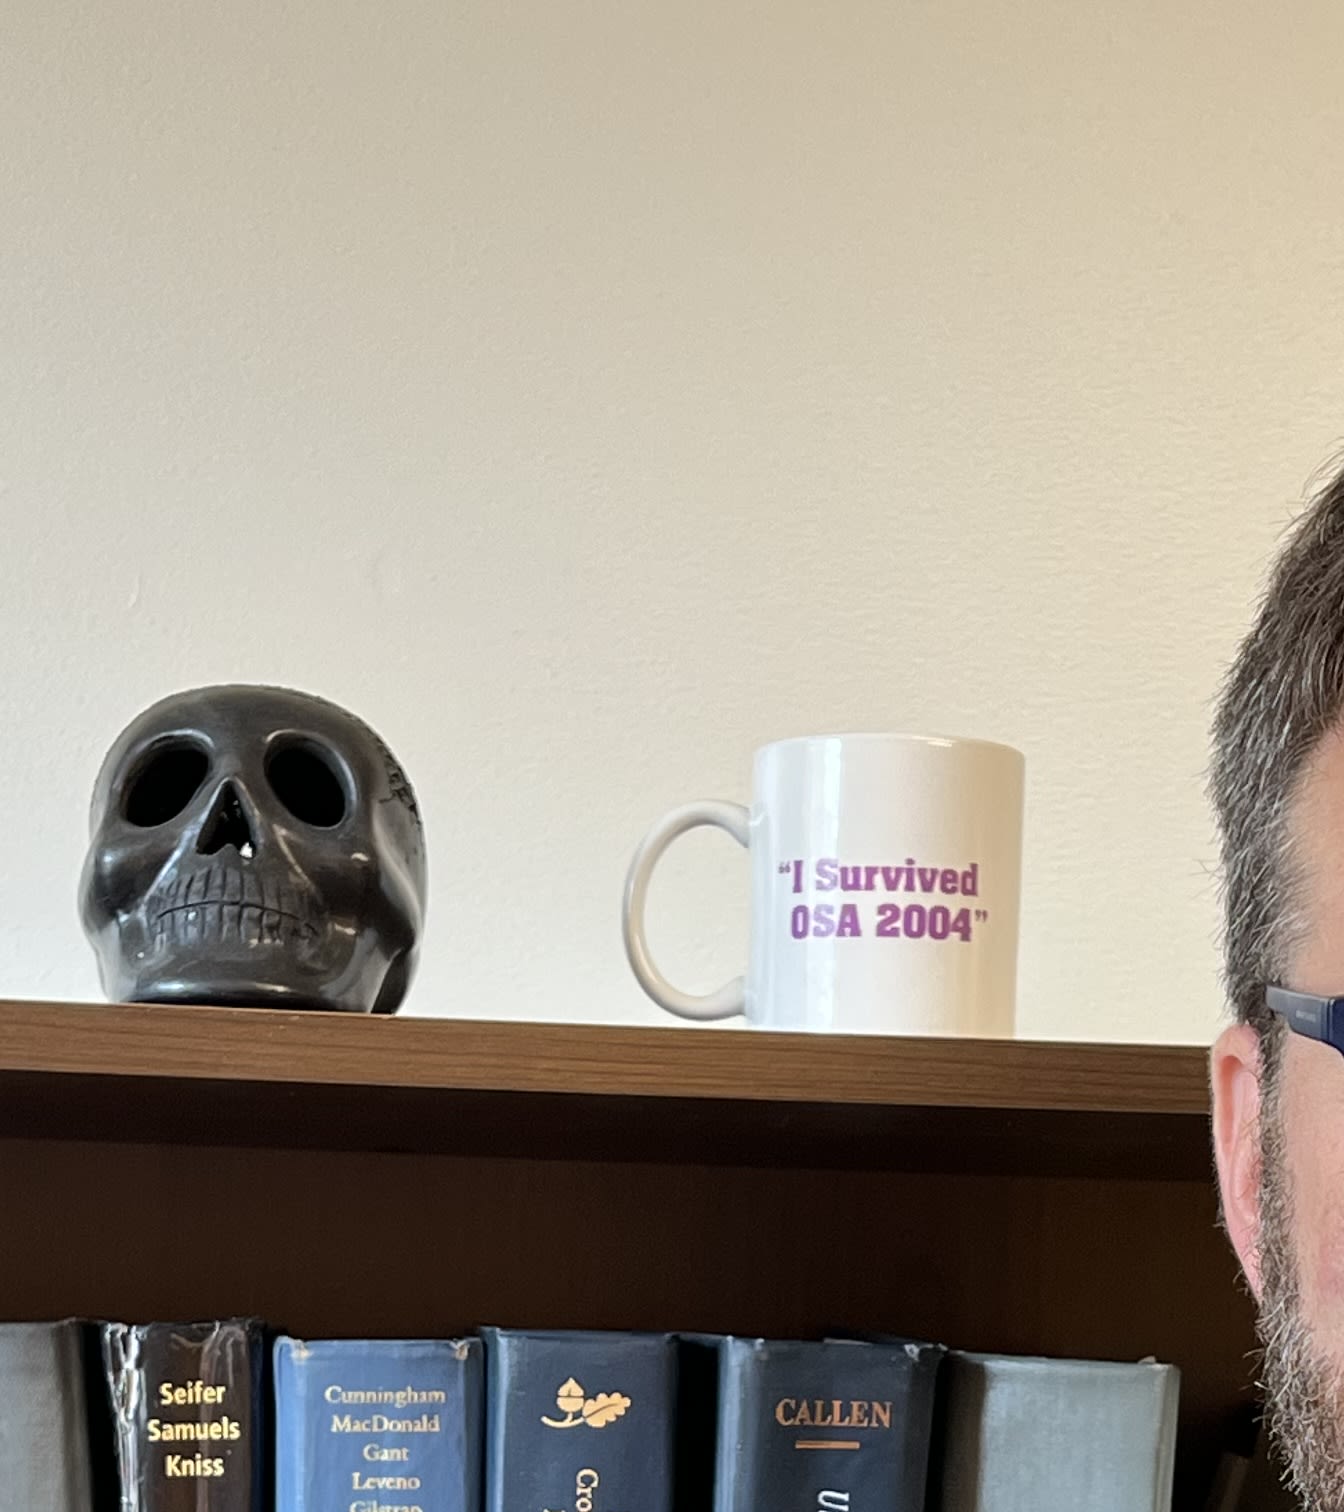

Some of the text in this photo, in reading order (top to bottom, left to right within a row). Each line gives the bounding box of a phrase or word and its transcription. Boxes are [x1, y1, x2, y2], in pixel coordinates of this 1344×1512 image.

[815, 858, 978, 896] Survived
[791, 904, 862, 939] OSA
[159, 1382, 226, 1404] Seifer
[324, 1385, 446, 1408] Cunningham
[331, 1413, 440, 1433] MacDonald
[775, 1397, 892, 1430] CALLEN
[147, 1417, 240, 1442] Samuels
[363, 1443, 409, 1462] Gant
[165, 1454, 224, 1477] Kniss
[352, 1473, 421, 1491] Leveno
